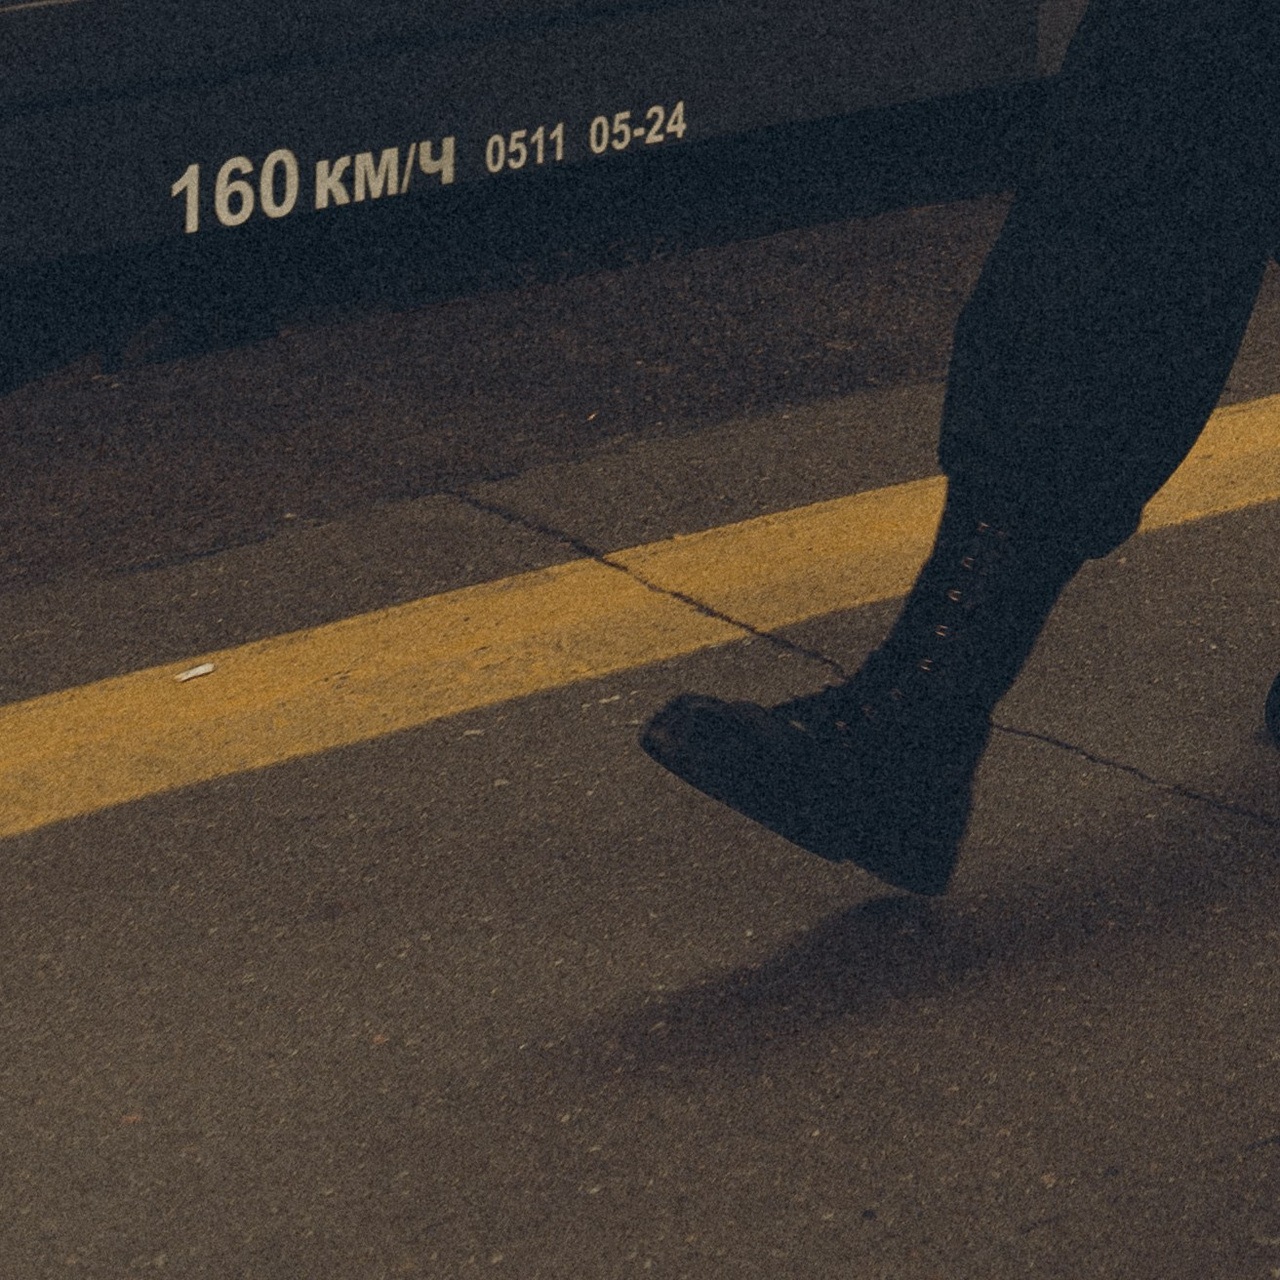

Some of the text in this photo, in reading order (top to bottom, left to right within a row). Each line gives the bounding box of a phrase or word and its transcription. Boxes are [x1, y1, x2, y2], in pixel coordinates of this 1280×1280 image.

[171, 147, 300, 234] 160
[486, 122, 566, 172] 0511
[588, 100, 687, 154] 05-24
